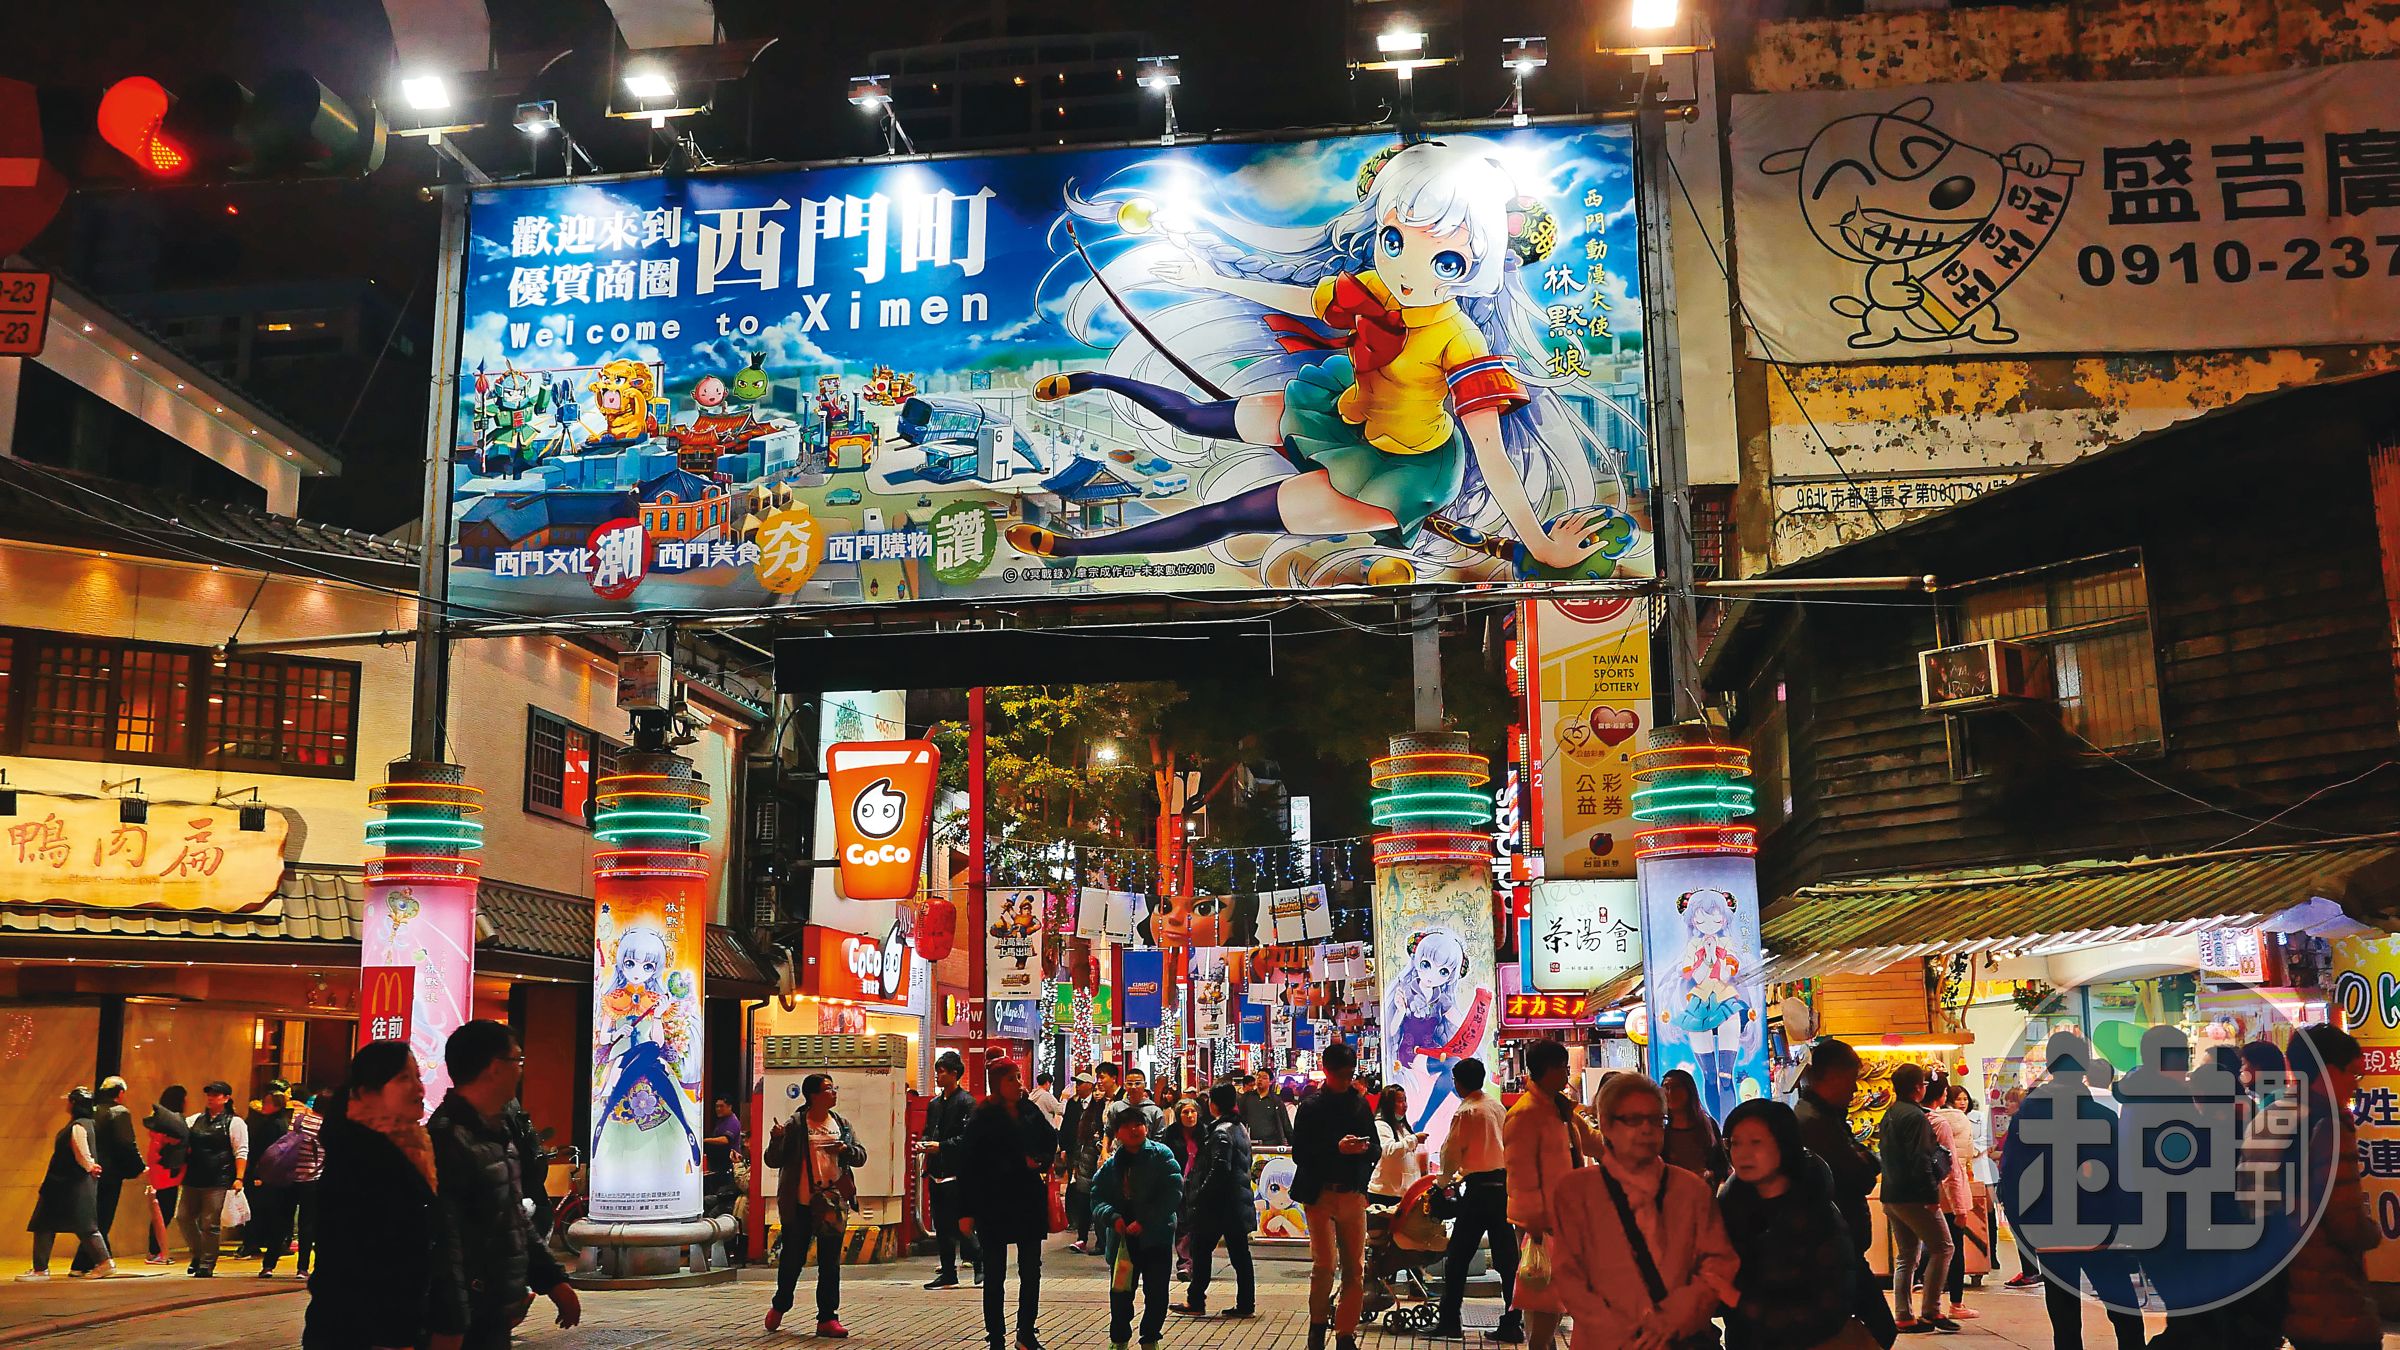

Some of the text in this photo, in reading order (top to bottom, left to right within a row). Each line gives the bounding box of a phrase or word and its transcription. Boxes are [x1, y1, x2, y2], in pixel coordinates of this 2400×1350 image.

[2103, 128, 2400, 226] 盛吉廣
[511, 206, 682, 258] 歡迎來到
[694, 186, 996, 295] 西門町
[507, 257, 680, 308] 優質商圈
[1584, 188, 1613, 338] 西門動漫大使
[2077, 236, 2400, 287] 0910-237
[509, 291, 989, 349] Welcome to Ximen
[1543, 263, 1591, 378] 林默娘
[1593, 655, 1639, 665] TAIWAN
[1594, 669, 1635, 679] SPORTS
[1594, 682, 1640, 692] LOTTERY
[8, 813, 225, 877] 鴨肉扁
[846, 844, 911, 866] CoCo
[842, 937, 882, 979] CoCo
[1543, 917, 1639, 954] 茶湯會
[371, 1016, 403, 1041] 往前
[969, 1030, 983, 1039] 02
[970, 1010, 983, 1022] W
